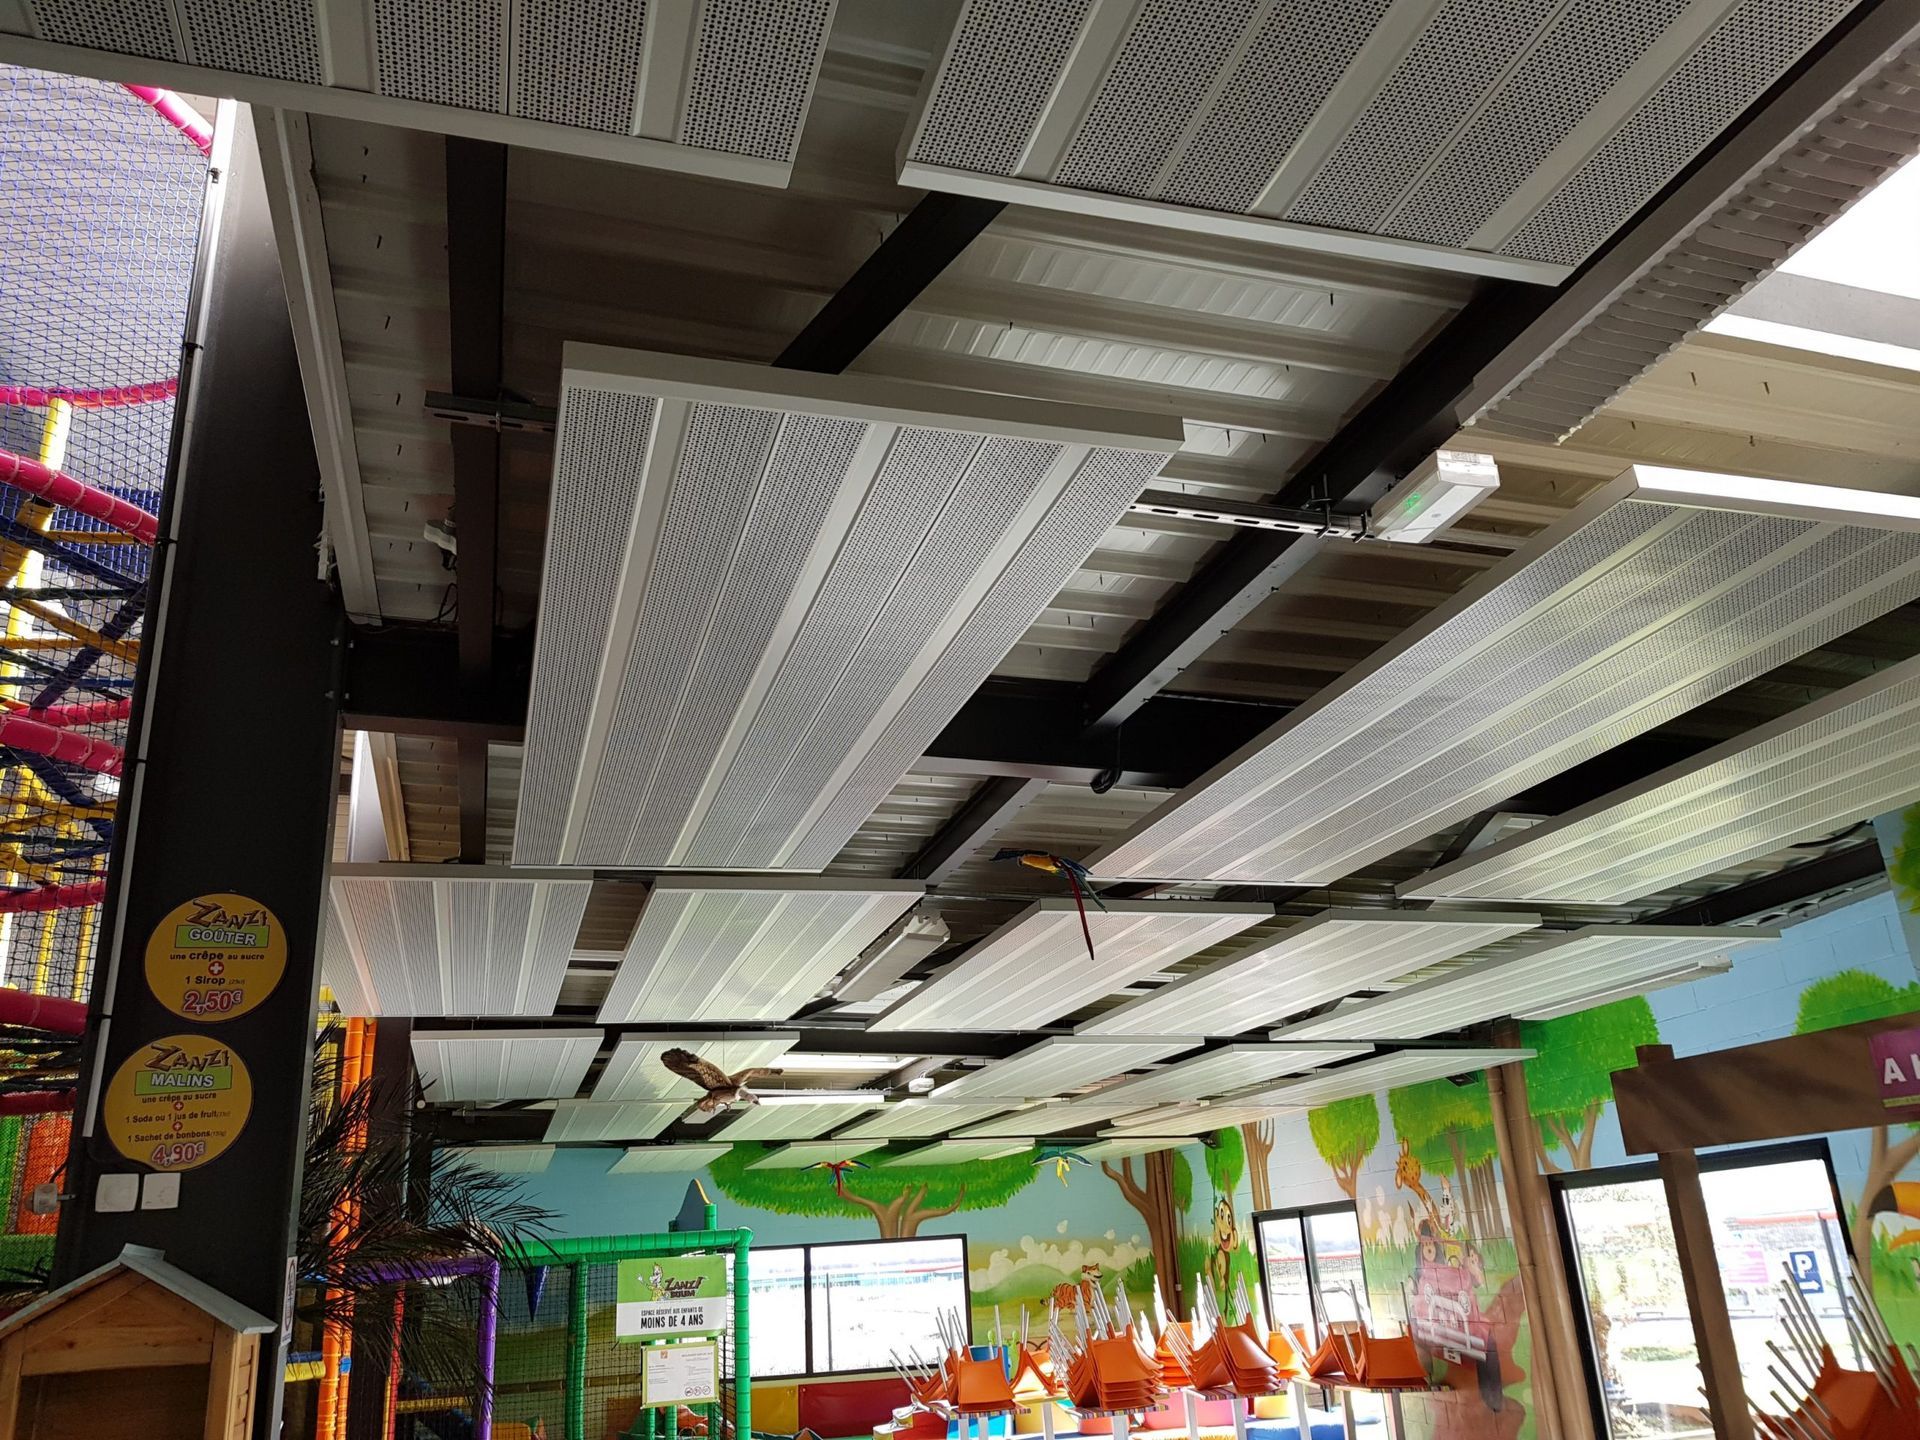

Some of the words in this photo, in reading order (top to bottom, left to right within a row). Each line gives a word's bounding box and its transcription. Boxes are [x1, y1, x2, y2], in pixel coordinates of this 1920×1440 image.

[189, 928, 257, 946] GOÛTER
[189, 951, 224, 962] crêpe
[185, 976, 190, 984] 1
[195, 975, 226, 986] Sirop
[183, 990, 243, 1014] 2,50€
[151, 1073, 214, 1088] MALINS
[142, 1096, 157, 1104] une
[159, 1093, 181, 1103] crêpe
[183, 1093, 193, 1101] au
[195, 1092, 217, 1100] sucre
[132, 1114, 153, 1123] Soda
[174, 1112, 187, 1122] jus
[189, 1111, 198, 1119] de
[128, 1135, 132, 1143] 1
[134, 1134, 162, 1143] Sachet
[164, 1133, 174, 1141] de
[152, 1142, 205, 1166] 4,90€
[1795, 1254, 1813, 1279] P
[681, 1306, 698, 1314] ENFANTS
[641, 1316, 665, 1329] MOINS
[669, 1315, 677, 1327] DE
[681, 1315, 685, 1326] 4
[689, 1314, 704, 1326] ANS
